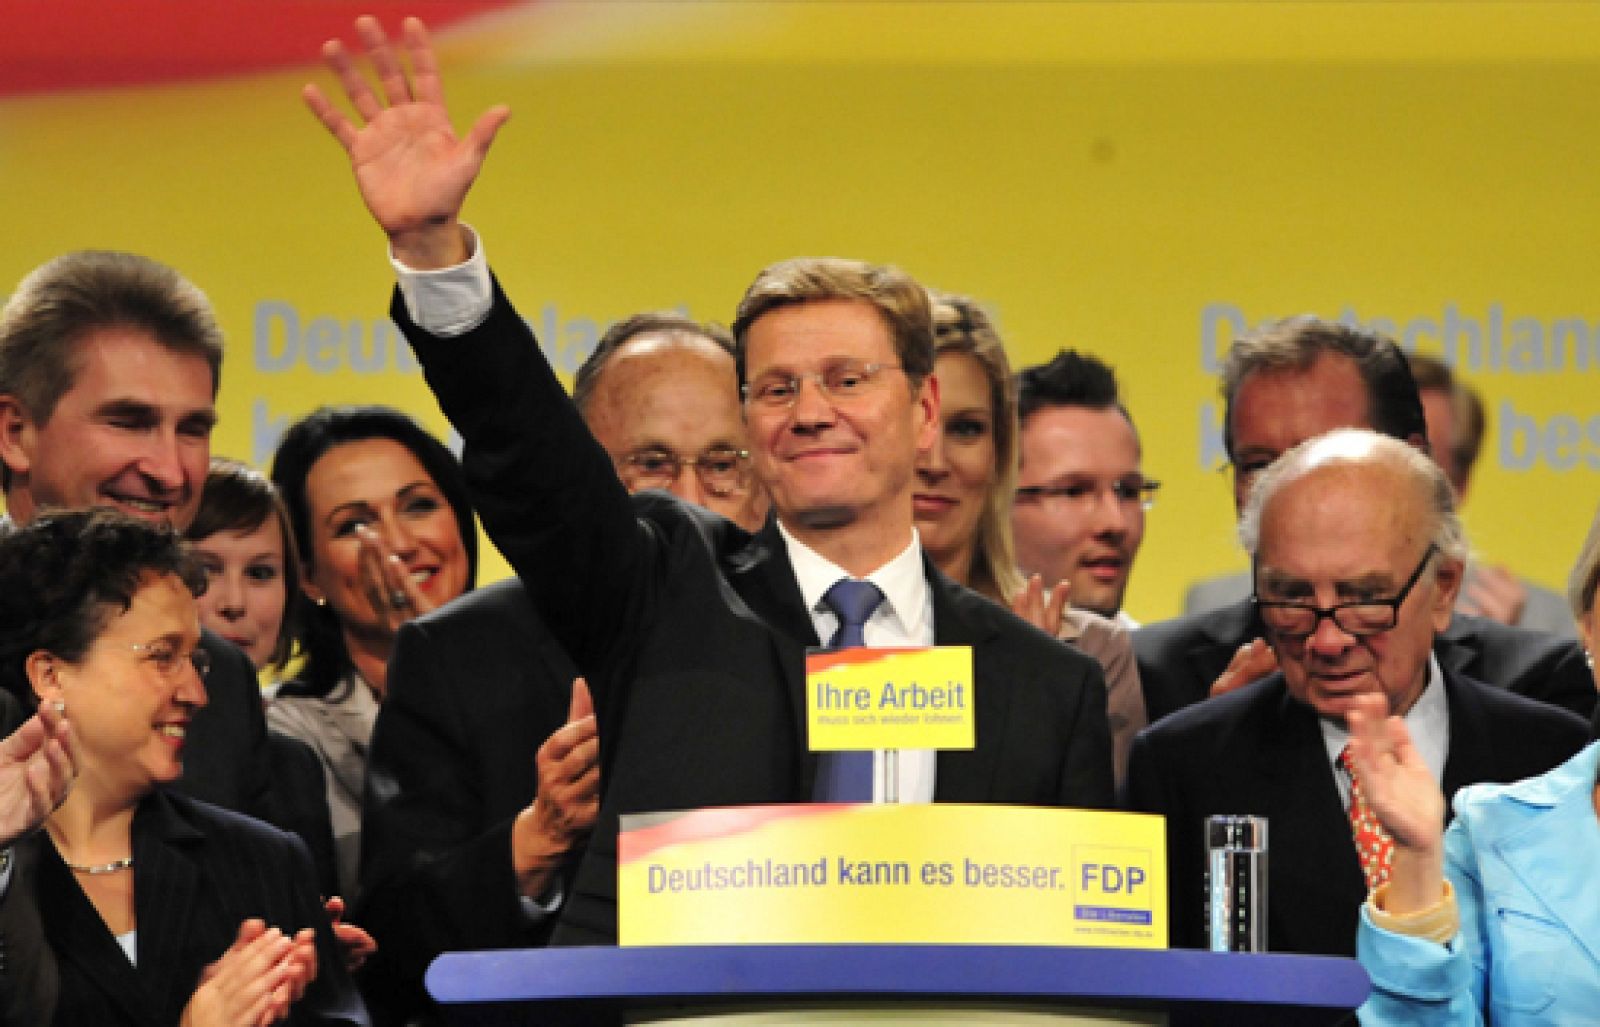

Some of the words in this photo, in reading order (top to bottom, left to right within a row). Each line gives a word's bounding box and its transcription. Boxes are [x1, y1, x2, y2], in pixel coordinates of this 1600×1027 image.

[817, 682, 871, 710] Ihre
[878, 681, 965, 710] Arbeit
[648, 856, 827, 893] Deutschland
[837, 855, 910, 886] kann
[920, 860, 954, 886] es
[963, 857, 1066, 890] besser.
[1080, 862, 1147, 895] FDP
